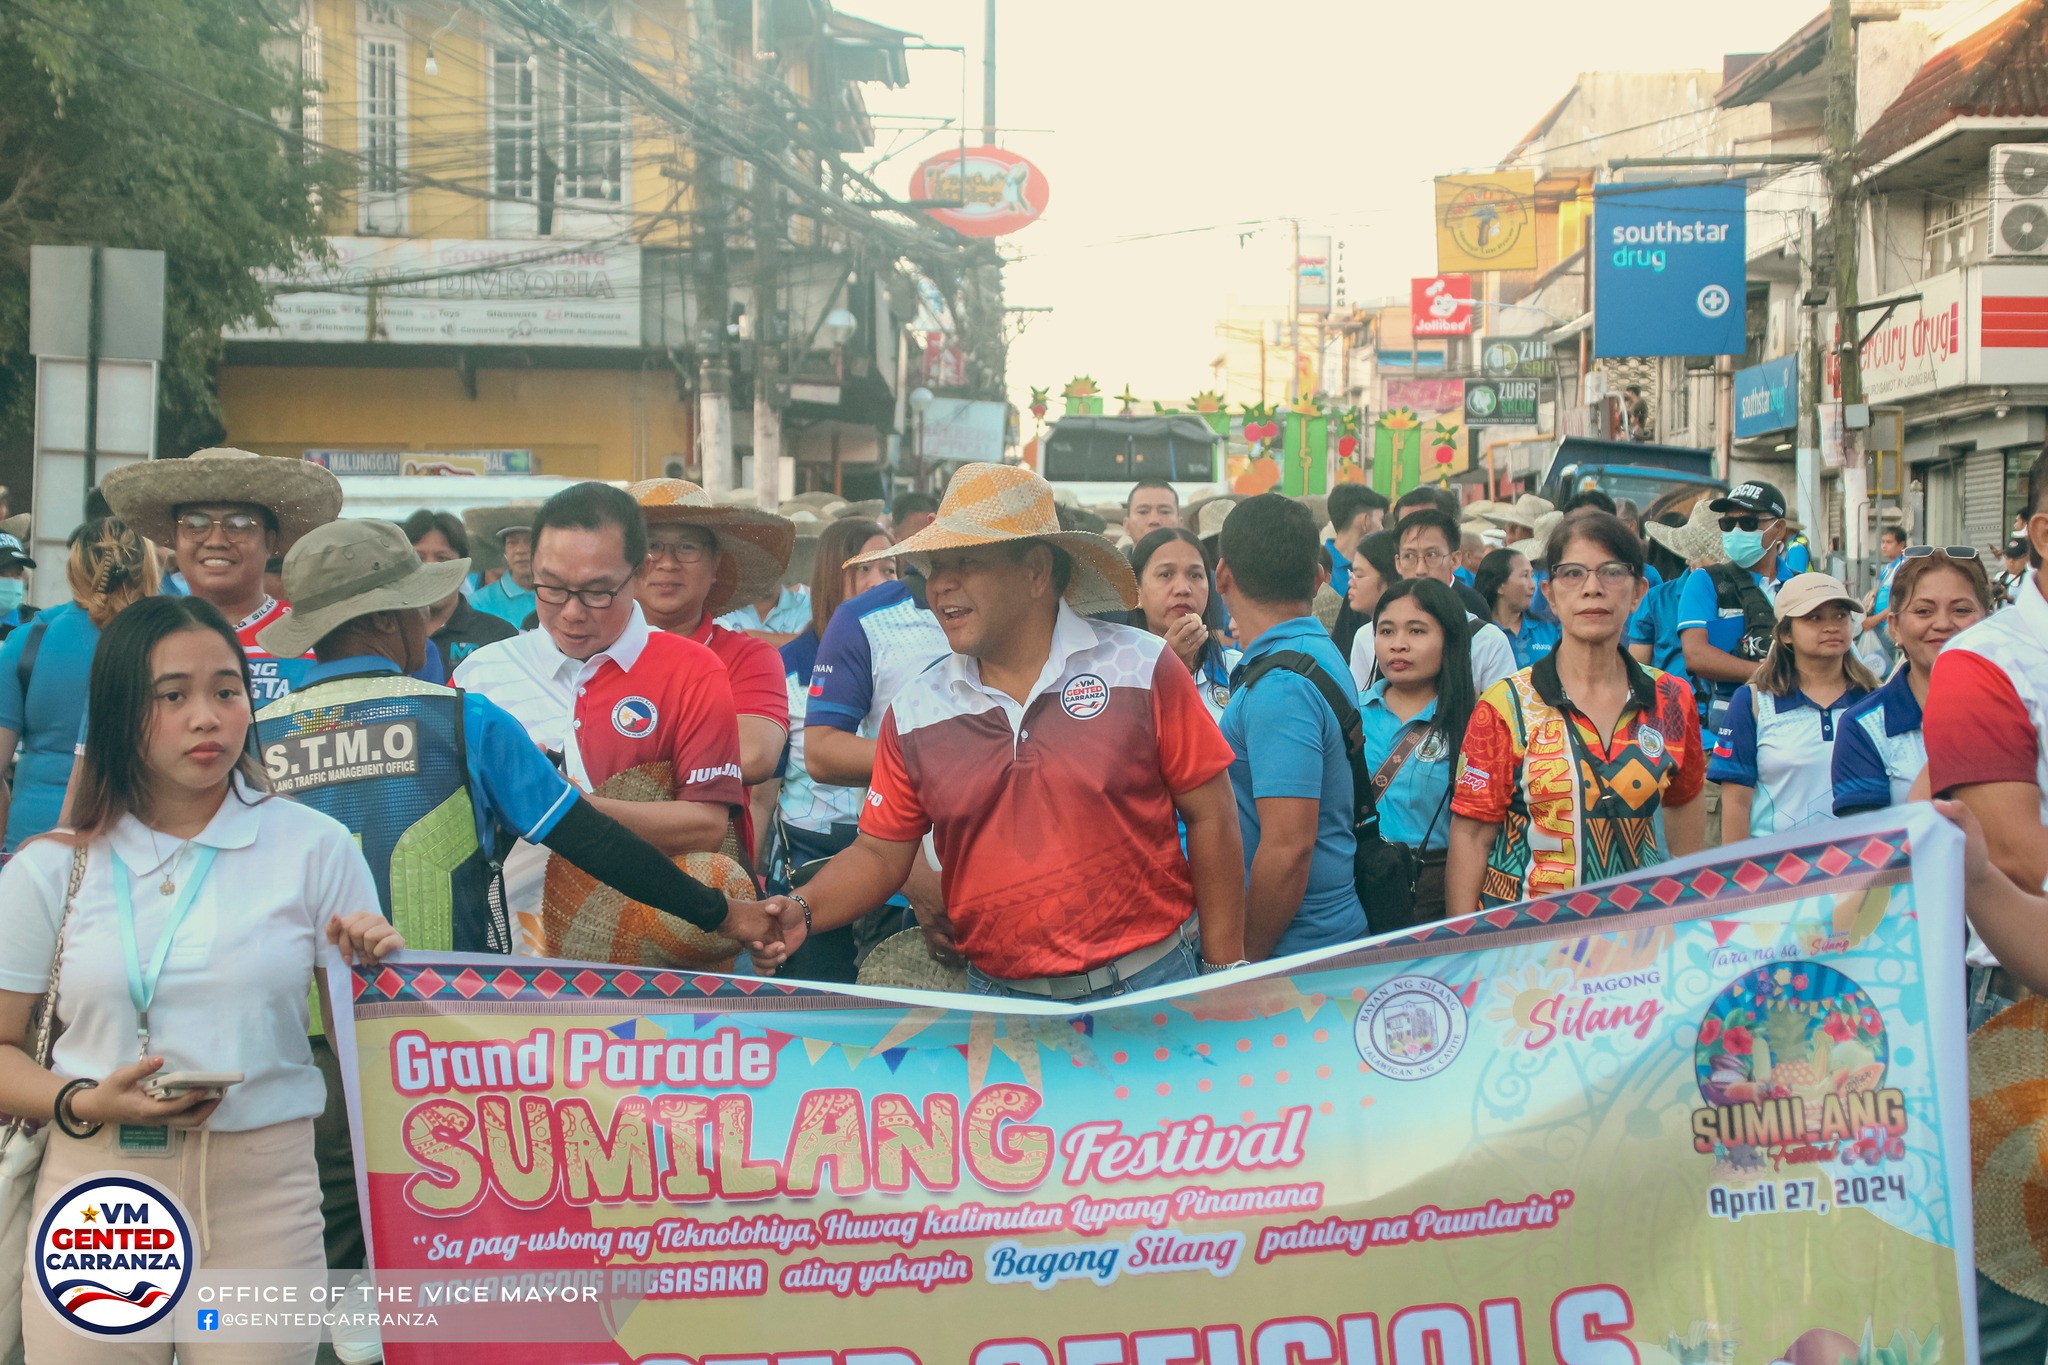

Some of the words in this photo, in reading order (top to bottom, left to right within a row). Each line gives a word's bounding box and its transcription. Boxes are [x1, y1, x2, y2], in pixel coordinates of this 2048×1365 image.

[1612, 221, 1729, 243] southstar
[1612, 246, 1667, 272] drug
[438, 268, 616, 300] DIVISORIA
[295, 305, 337, 316] Supplies
[355, 306, 380, 317] Pay
[439, 309, 460, 319] Toys
[487, 309, 537, 319] Glassware
[564, 310, 621, 320] Plasticware
[316, 323, 367, 332] Kitchenwar
[1416, 317, 1468, 332] Jollibee
[1859, 325, 1908, 372] ercury
[1912, 308, 1950, 363] drug
[1498, 382, 1536, 400] ZURIS
[1742, 386, 1770, 419] southstar
[1501, 400, 1534, 413] SALON
[329, 453, 399, 470] MALUNGGAY
[1065, 692, 1105, 702] CARRANZA
[1066, 685, 1103, 697] GENTED
[1080, 679, 1095, 687] VM
[265, 724, 414, 780] S.T.M.O
[295, 771, 327, 788] TRAFFIC
[328, 763, 384, 781] MANAGEMENT
[386, 759, 415, 773] OFFICE
[1527, 719, 1576, 898] ILANG
[1707, 945, 1749, 969] Tara
[1754, 948, 1775, 960] na
[1779, 944, 1800, 958] sa
[1583, 971, 1661, 995] BAGONG
[1360, 988, 1390, 1022] BAYAN
[1393, 979, 1413, 992] NG
[1420, 980, 1460, 1011] SILANG
[1524, 993, 1665, 1050] Silang
[393, 1031, 551, 1093] Grand
[567, 1030, 772, 1085] Parade
[1363, 1046, 1413, 1076] LALAWIGAN
[1419, 1065, 1435, 1075] NG
[1438, 1034, 1462, 1065] CAVITE
[1692, 1088, 1908, 1154] SUMILANG
[404, 1084, 1053, 1216] SUMILANG
[1064, 1108, 1309, 1183] Festival
[1709, 1183, 1776, 1220] April
[1784, 1180, 1828, 1212] 27,
[1834, 1174, 1907, 1206] 2024
[465, 1227, 611, 1265] pag-usbong
[617, 1229, 652, 1257] ng
[657, 1216, 816, 1251] Teknolohiya,
[822, 1213, 919, 1242] Huwag
[923, 1204, 1064, 1236] kalimutan
[1070, 1197, 1170, 1231] Lupang
[1176, 1186, 1319, 1217] Pinamana
[611, 1264, 763, 1294] PAGSASAKA
[784, 1261, 852, 1293] ating
[857, 1254, 968, 1293] yakapin
[991, 1245, 1120, 1283] Bagong
[1127, 1236, 1238, 1270] Silang
[1259, 1221, 1367, 1259] patuloy
[1371, 1218, 1408, 1241] na
